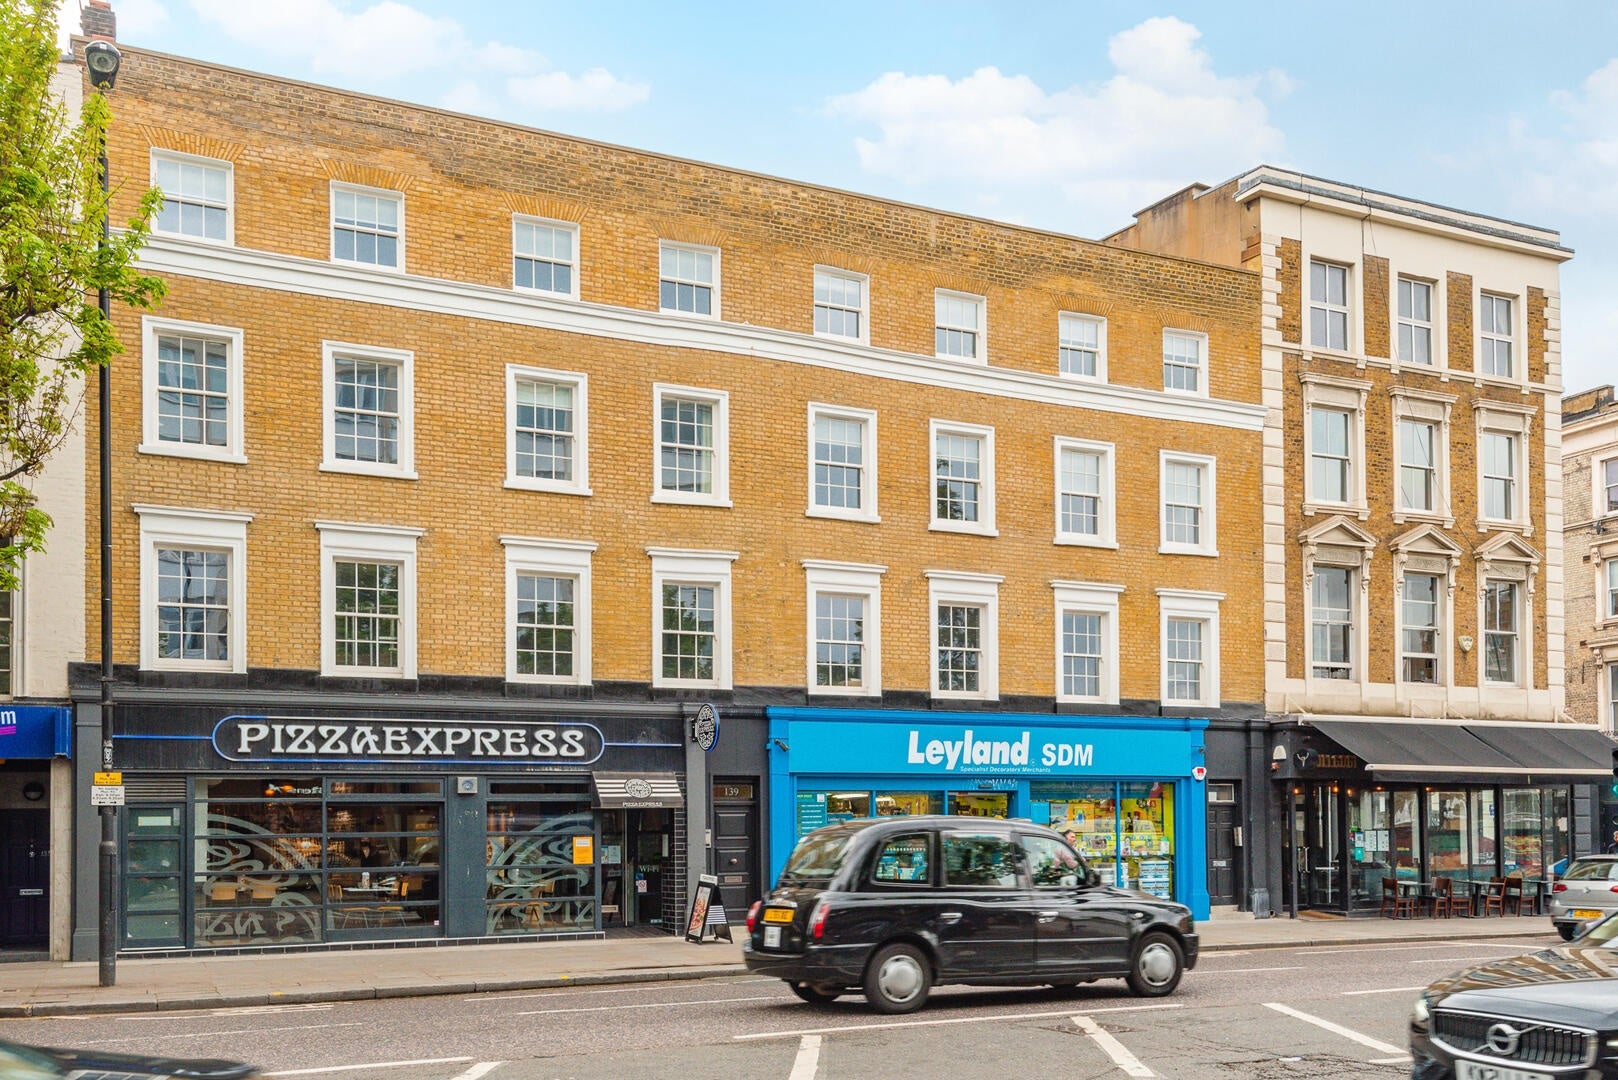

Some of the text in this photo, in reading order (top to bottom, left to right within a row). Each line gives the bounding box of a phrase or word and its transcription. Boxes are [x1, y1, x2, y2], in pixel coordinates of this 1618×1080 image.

[907, 730, 1093, 770] Leyland SDM
[724, 787, 739, 796] 139
